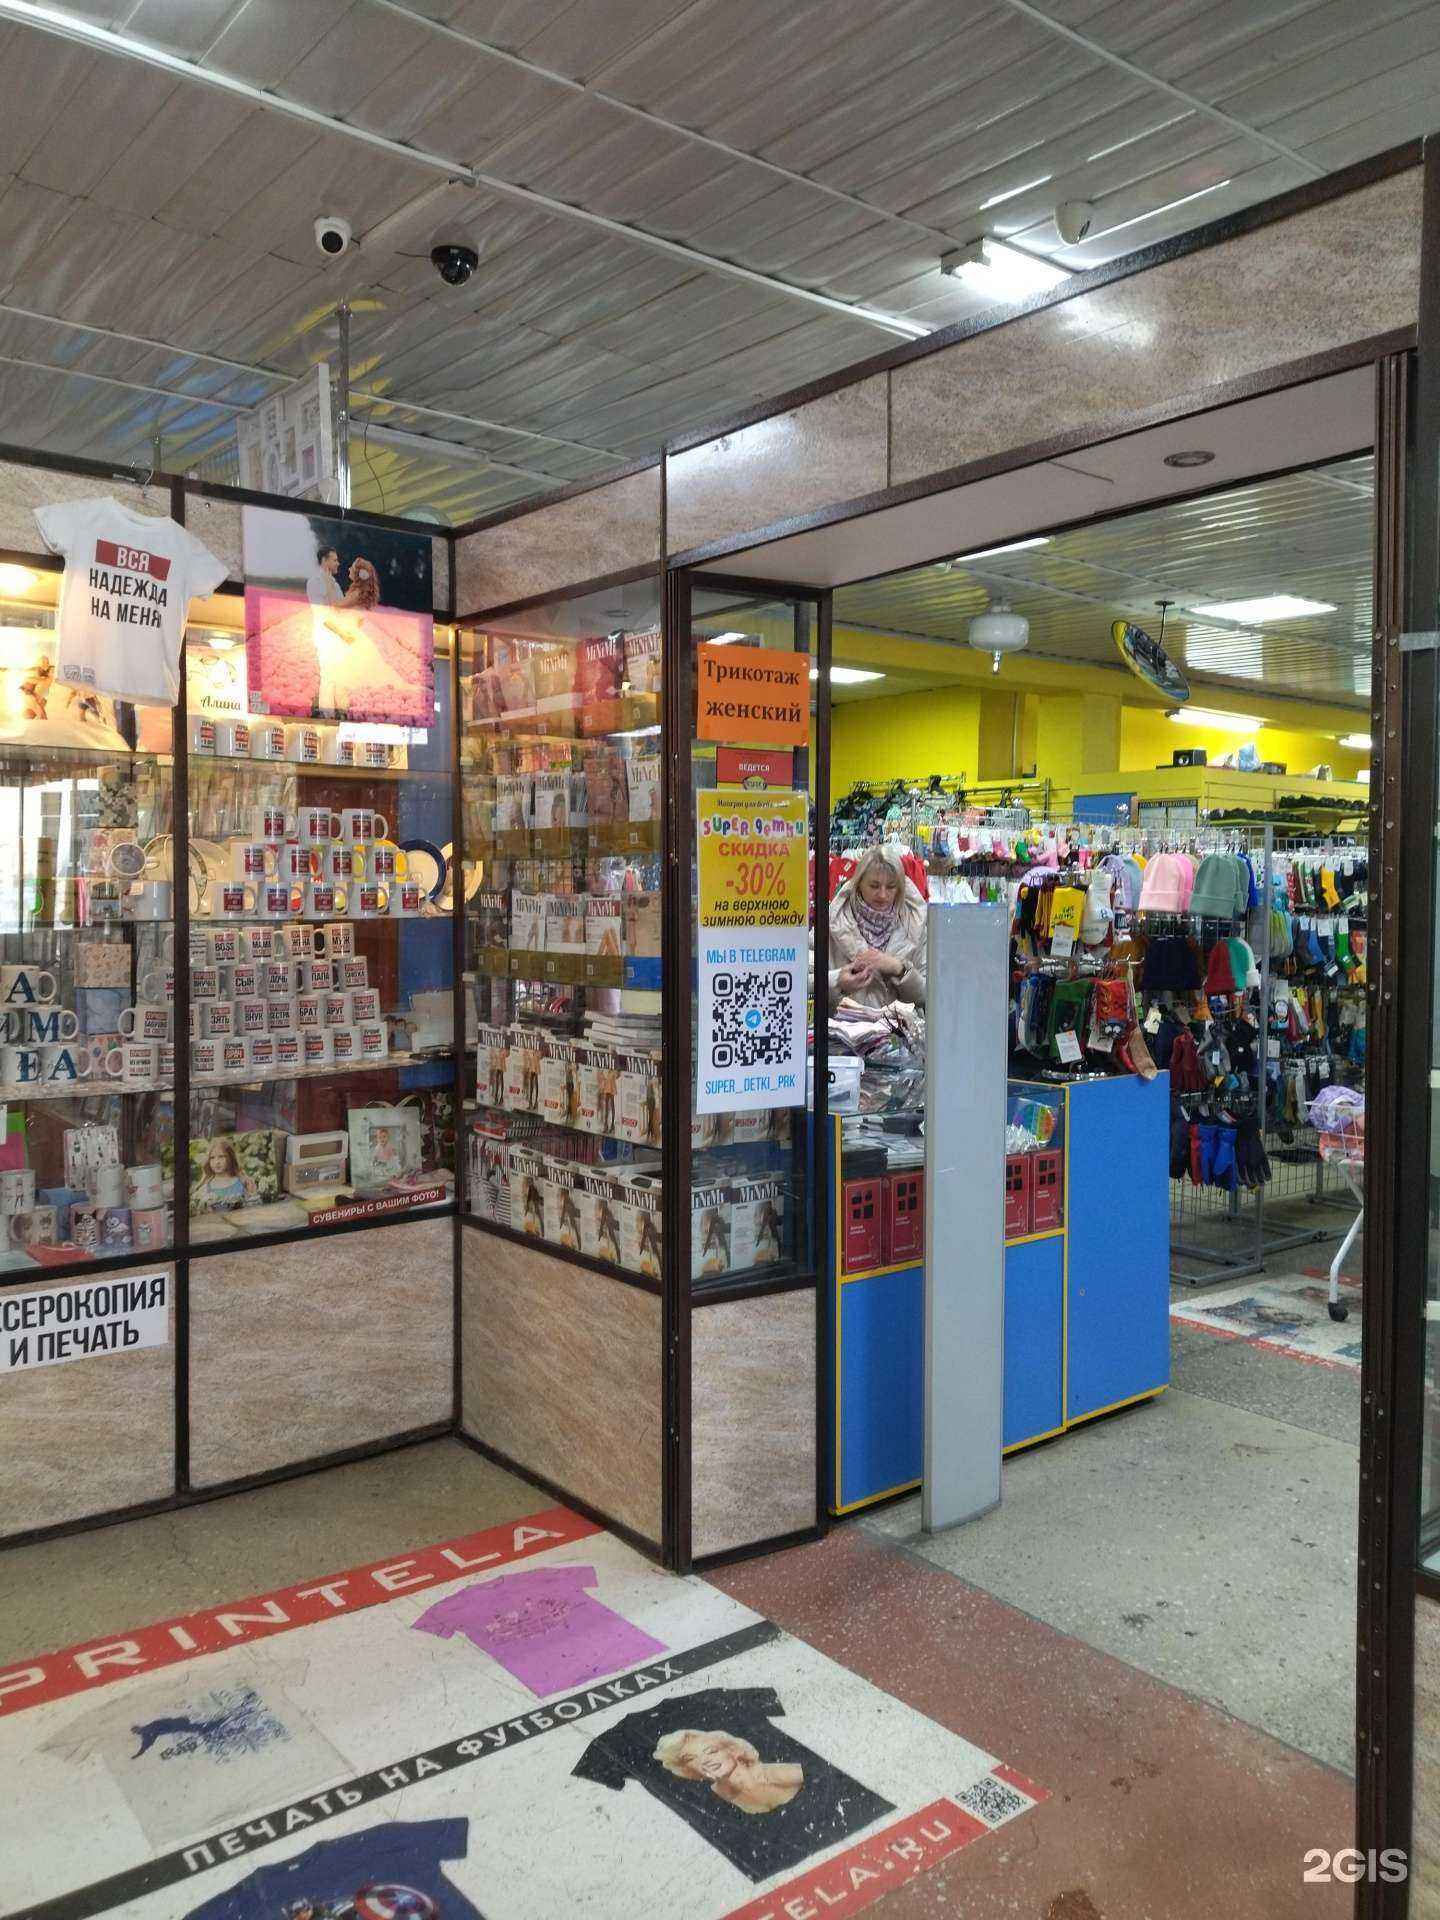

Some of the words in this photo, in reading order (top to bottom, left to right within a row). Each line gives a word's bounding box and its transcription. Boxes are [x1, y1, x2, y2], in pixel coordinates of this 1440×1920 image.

[117, 547, 150, 571] ВСЯ
[89, 567, 168, 607] НАДЕЖДА
[91, 596, 111, 620] НА
[116, 603, 162, 628] МЕНЯ
[704, 659, 801, 686] Трикотаж
[200, 693, 242, 711] Алина
[705, 700, 801, 724] женский
[718, 842, 790, 858] СКИДКА
[726, 862, 786, 897] -30%
[703, 916, 755, 927] зимнюю
[759, 912, 804, 926] одежду
[714, 900, 730, 911] на
[733, 899, 790, 912] верхнюю
[706, 949, 727, 964] МЫ
[729, 950, 737, 964] В
[741, 948, 796, 963] TELEGRAM
[313, 1204, 365, 1224] СУВЕНИРЫ
[367, 1203, 375, 1212] С
[376, 1197, 410, 1210] ВАШИМ
[411, 1189, 439, 1203] ФОТО!
[0, 1277, 166, 1333] СЕРОКОПИЯ
[10, 1337, 28, 1367] И
[37, 1319, 140, 1362] ПЕЧАТЬ
[0, 1526, 566, 1707] PRINTELA
[183, 1787, 364, 1873] ПЕЧАТЬ
[379, 1755, 443, 1791] НА
[455, 1661, 685, 1758] ФУТБОЛКАХ
[757, 1820, 952, 1920] ELA.RU
